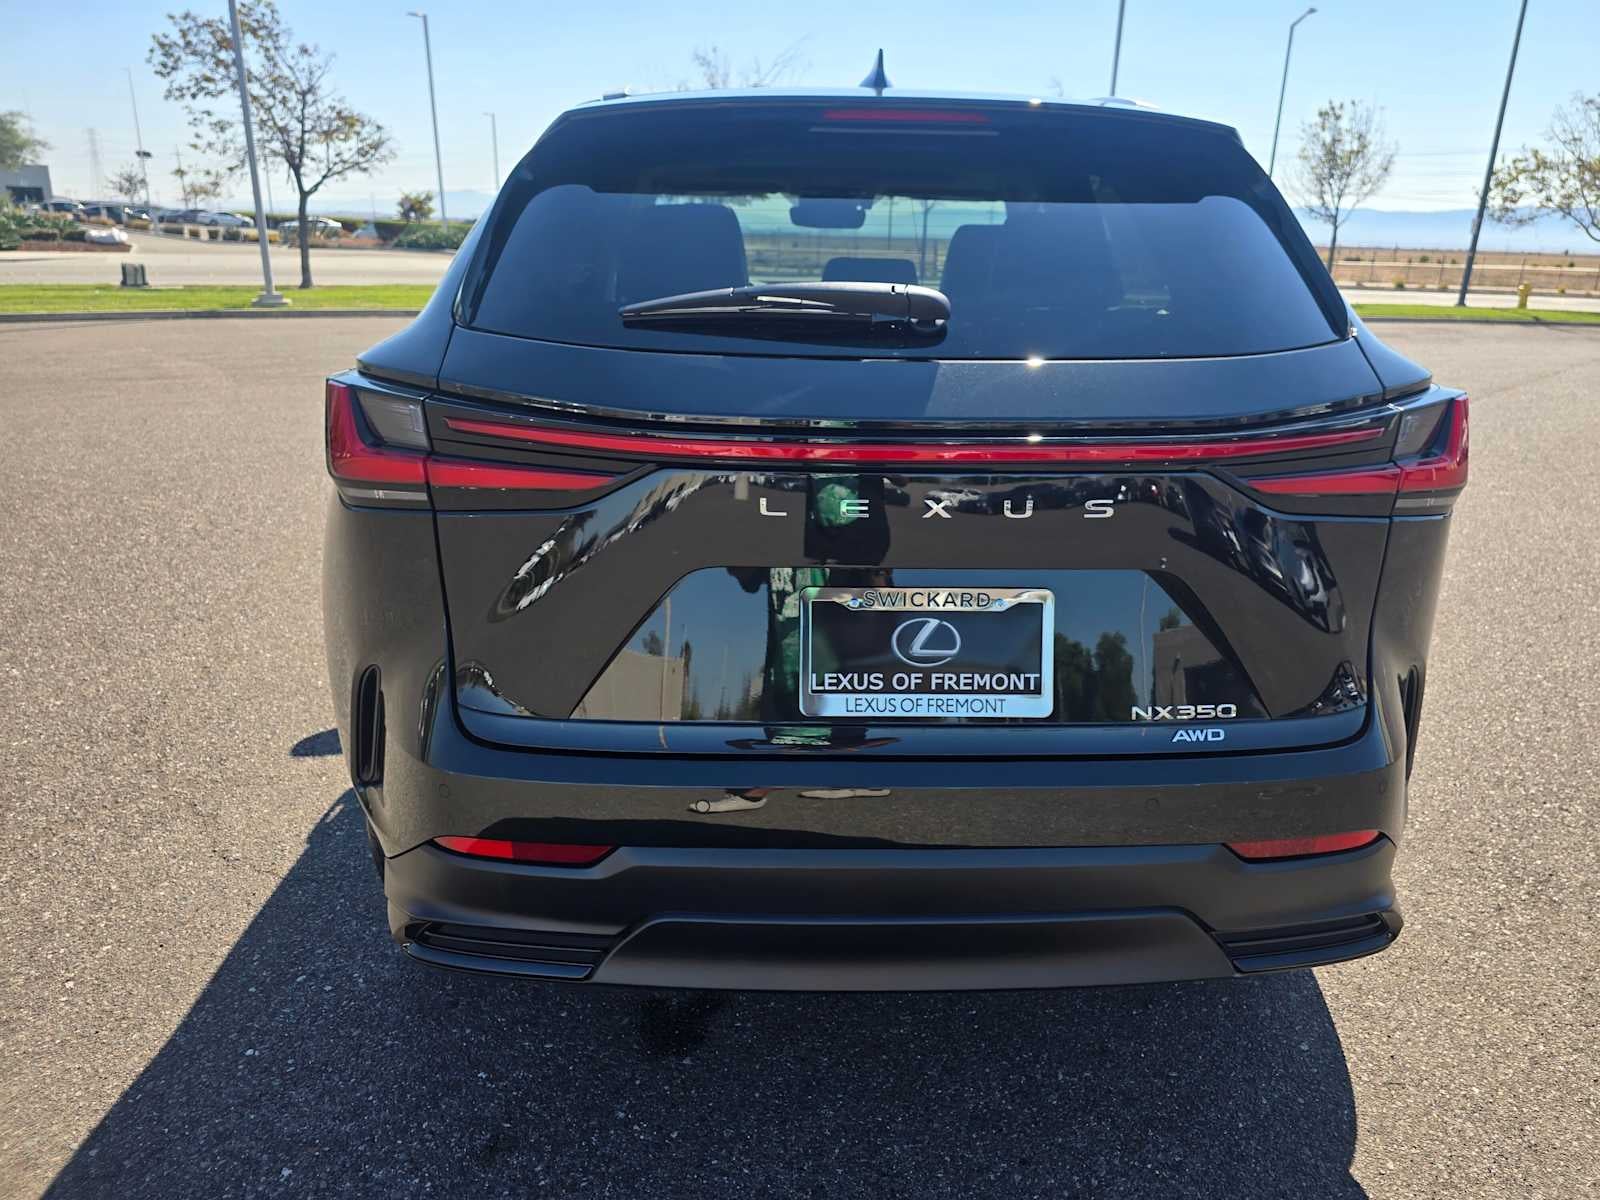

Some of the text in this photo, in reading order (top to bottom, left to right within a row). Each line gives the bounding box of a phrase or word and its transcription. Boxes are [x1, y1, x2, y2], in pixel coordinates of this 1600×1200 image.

[759, 497, 1115, 519] LEXUS
[864, 591, 991, 608] SWICKARD
[811, 672, 1041, 691] LEXUS OF FREMONT
[845, 697, 1007, 714] LEXUS OF FREMONT
[1131, 703, 1238, 721] NX350
[1171, 728, 1226, 743] AWD
